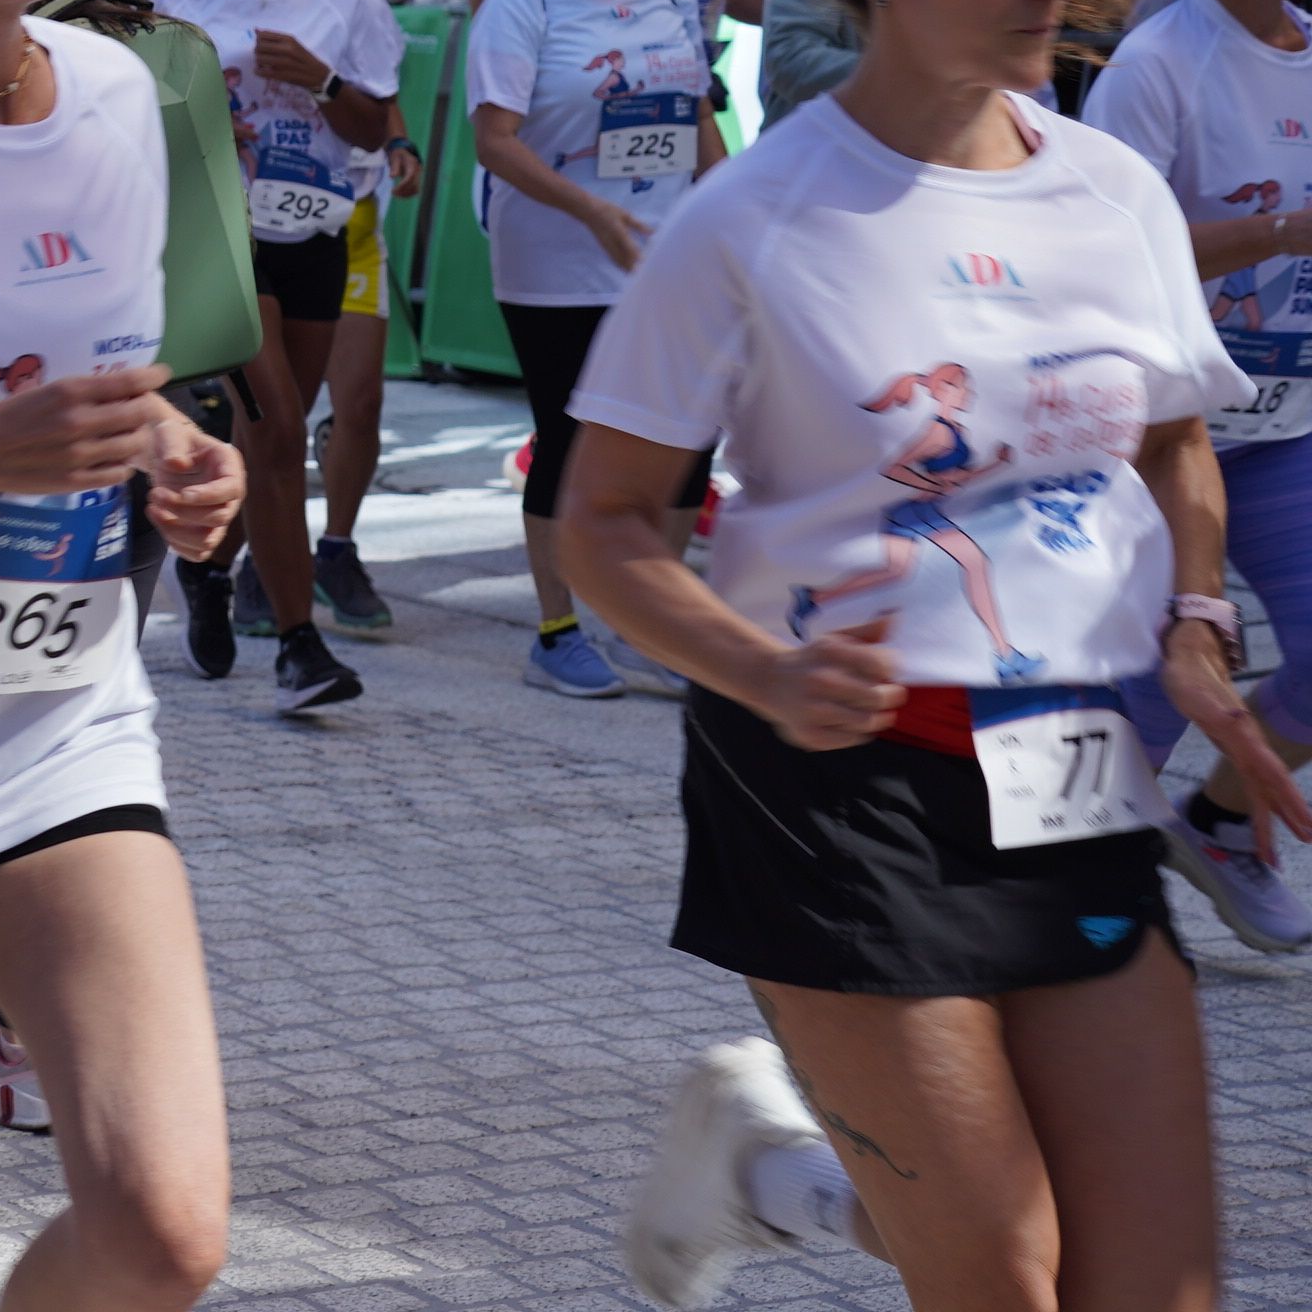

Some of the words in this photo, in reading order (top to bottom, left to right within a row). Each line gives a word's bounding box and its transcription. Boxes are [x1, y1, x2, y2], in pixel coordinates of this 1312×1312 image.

[626, 131, 676, 160] 225
[277, 190, 330, 221] 292
[1222, 380, 1290, 415] 18
[1058, 726, 1109, 802] 77
